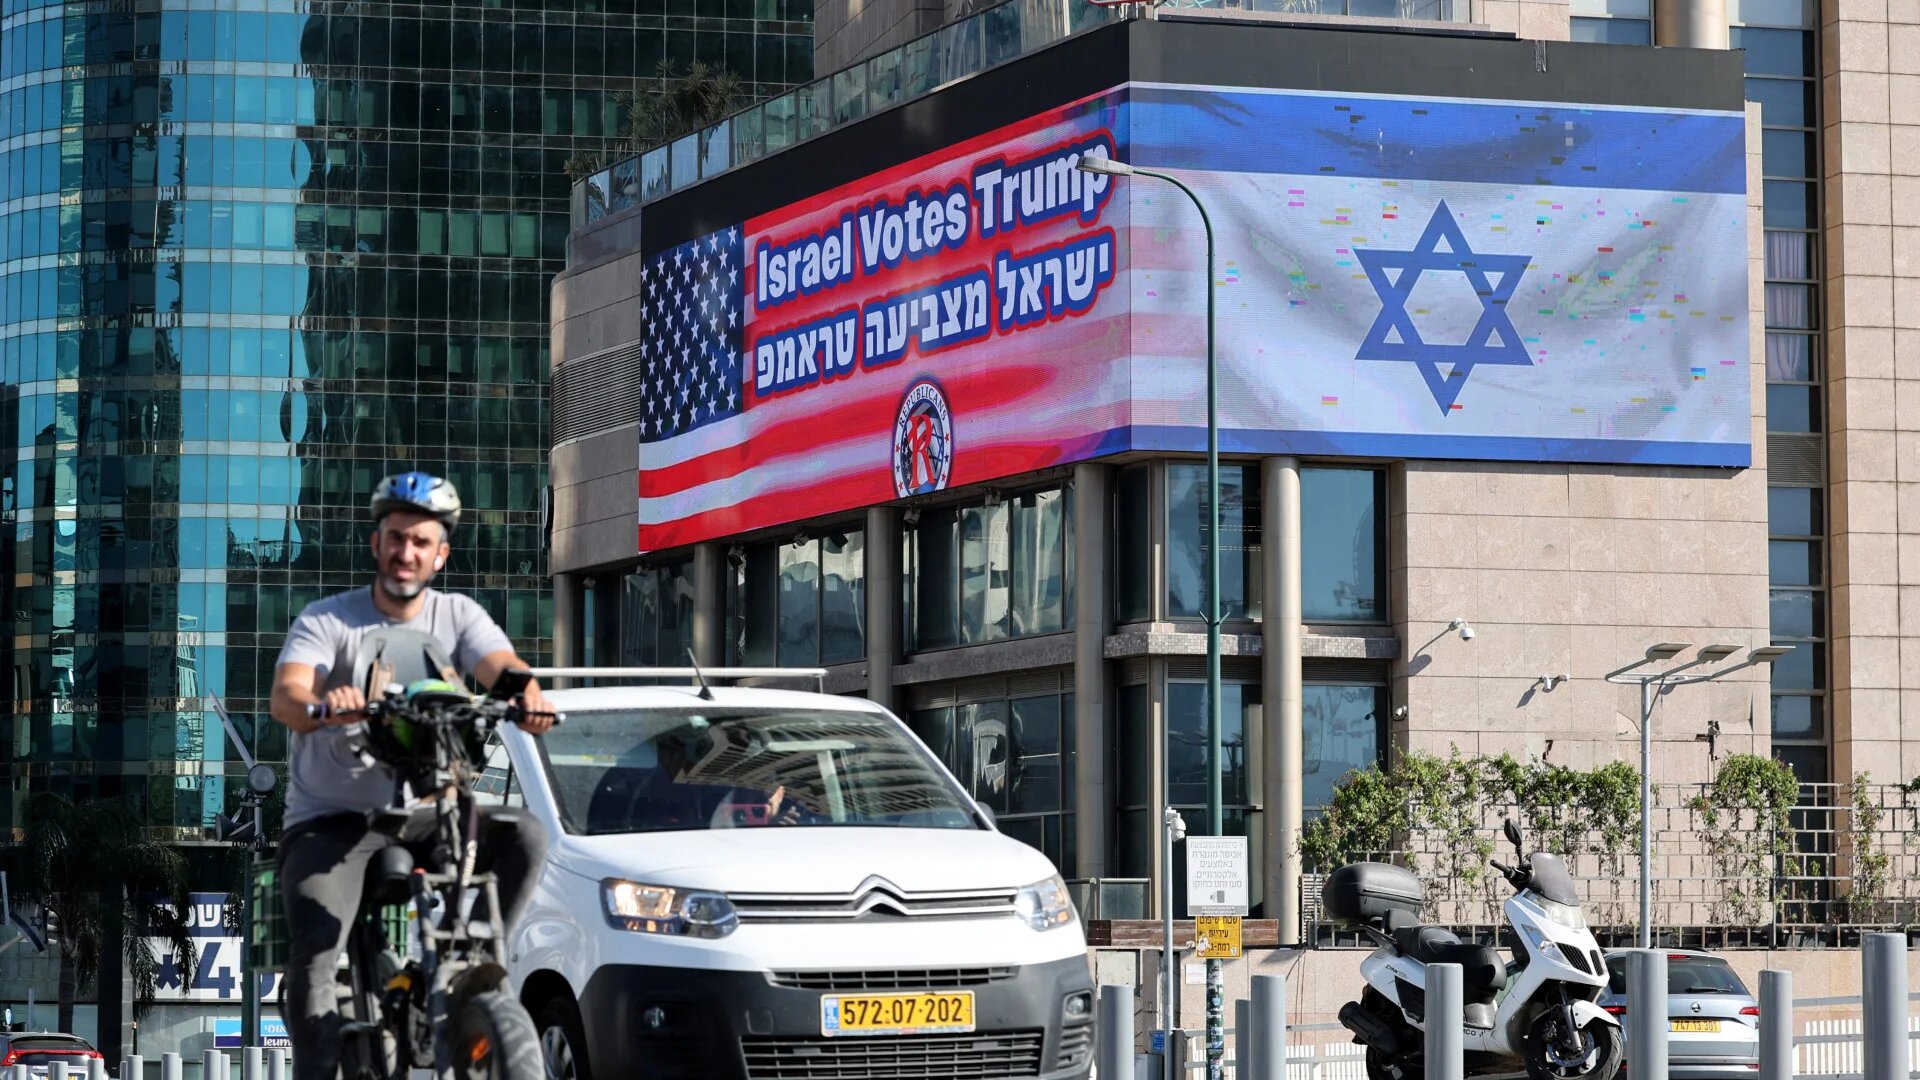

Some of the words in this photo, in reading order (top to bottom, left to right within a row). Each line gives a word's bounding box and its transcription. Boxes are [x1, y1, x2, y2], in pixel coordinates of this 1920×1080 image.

[759, 220, 851, 302] Israel
[859, 193, 967, 267] Votes
[976, 144, 1109, 230] Trump
[998, 243, 1109, 321] ישראל
[757, 318, 856, 389] טראמפ
[866, 279, 987, 359] מצביעה
[898, 386, 947, 428] REPUBLICANS
[1199, 860, 1233, 868] באמצעים
[263, 1024, 288, 1034] אומי
